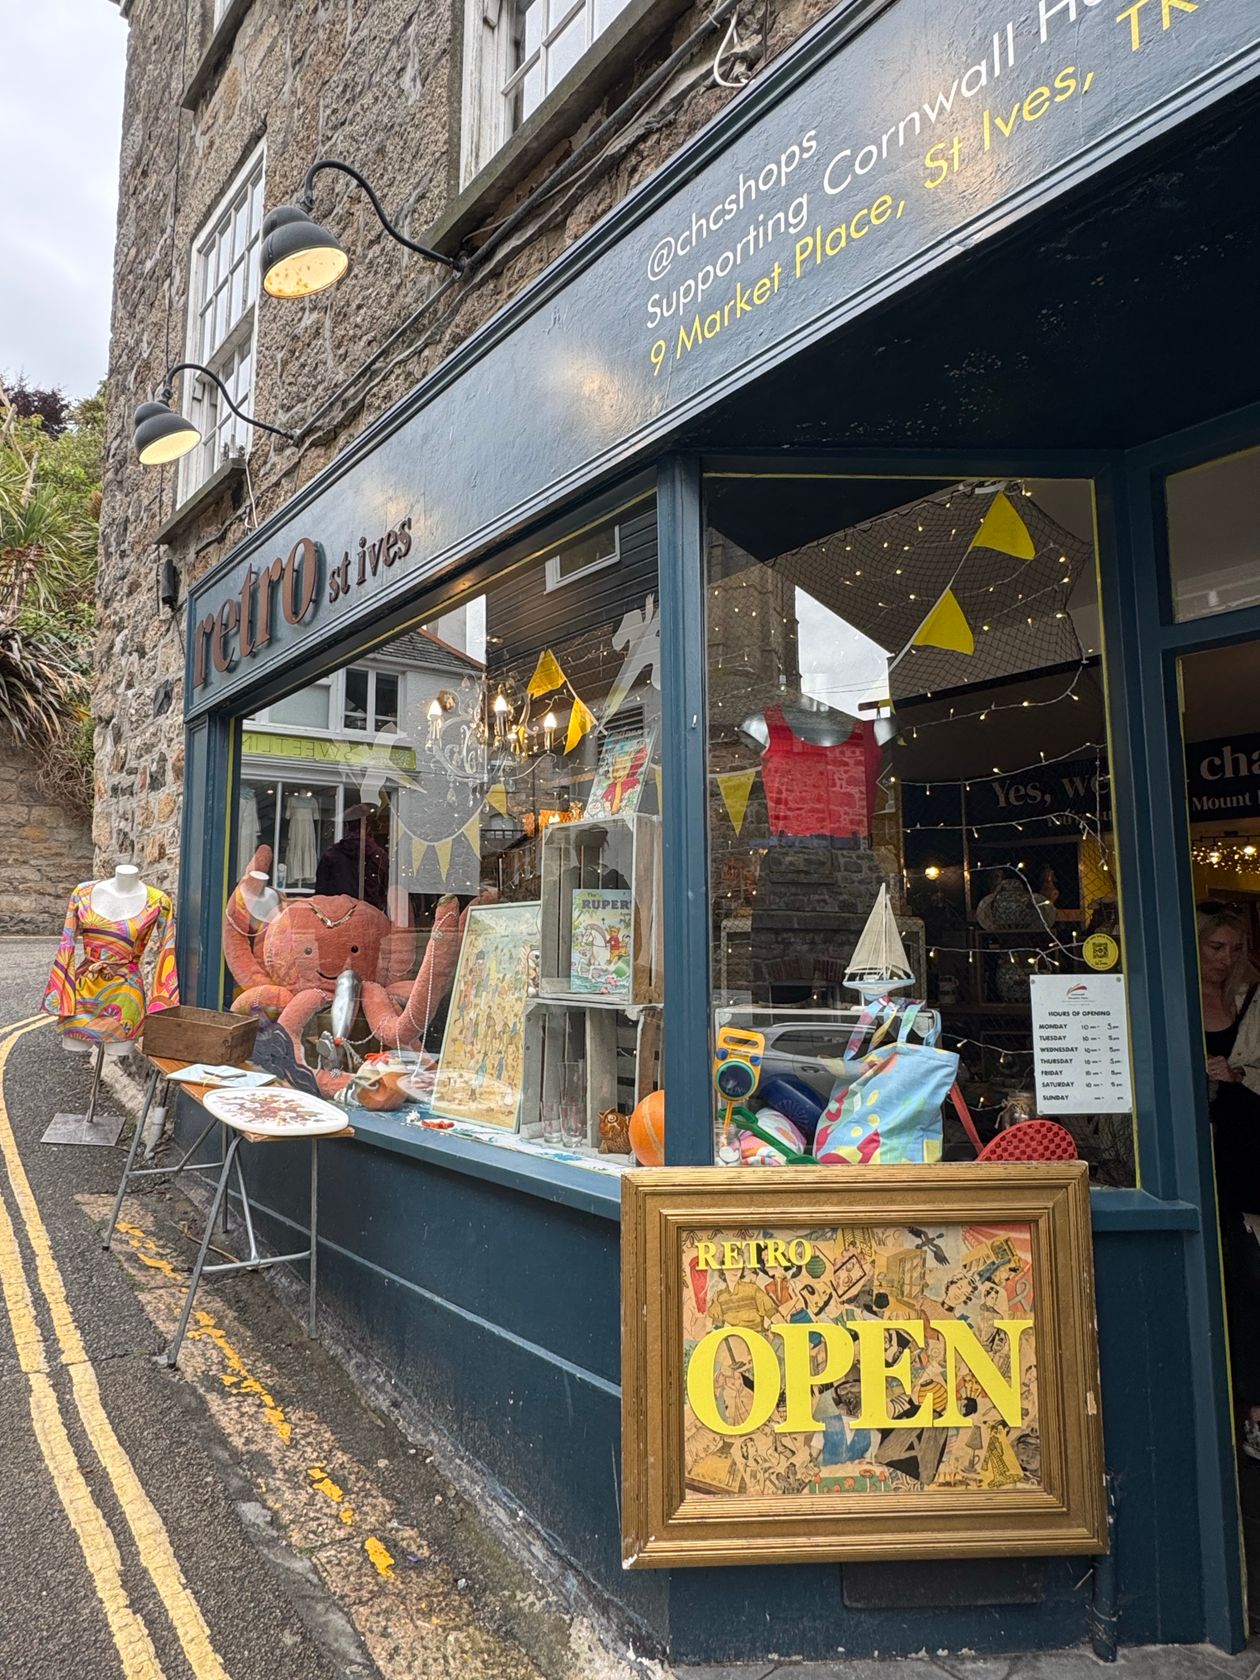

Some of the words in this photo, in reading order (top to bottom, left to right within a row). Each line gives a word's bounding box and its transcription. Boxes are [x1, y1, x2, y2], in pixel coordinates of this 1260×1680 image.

[646, 192, 808, 329] Supporting
[822, 22, 1015, 195] Cornwall
[1038, 0, 1101, 43] H
[647, 129, 818, 281] @chcshops
[650, 340, 667, 376] 9
[676, 261, 782, 360] Market
[795, 194, 906, 279] Place,
[923, 134, 962, 189] St
[982, 66, 1095, 151] Ives,
[193, 537, 317, 689] retro
[328, 551, 350, 603] st
[356, 517, 413, 585] ives
[991, 778, 1051, 808] Yes,
[1192, 792, 1254, 811] Mount
[582, 899, 632, 910] RUPER
[696, 1237, 813, 1271] RETRO
[686, 1318, 1034, 1436] OPEN
